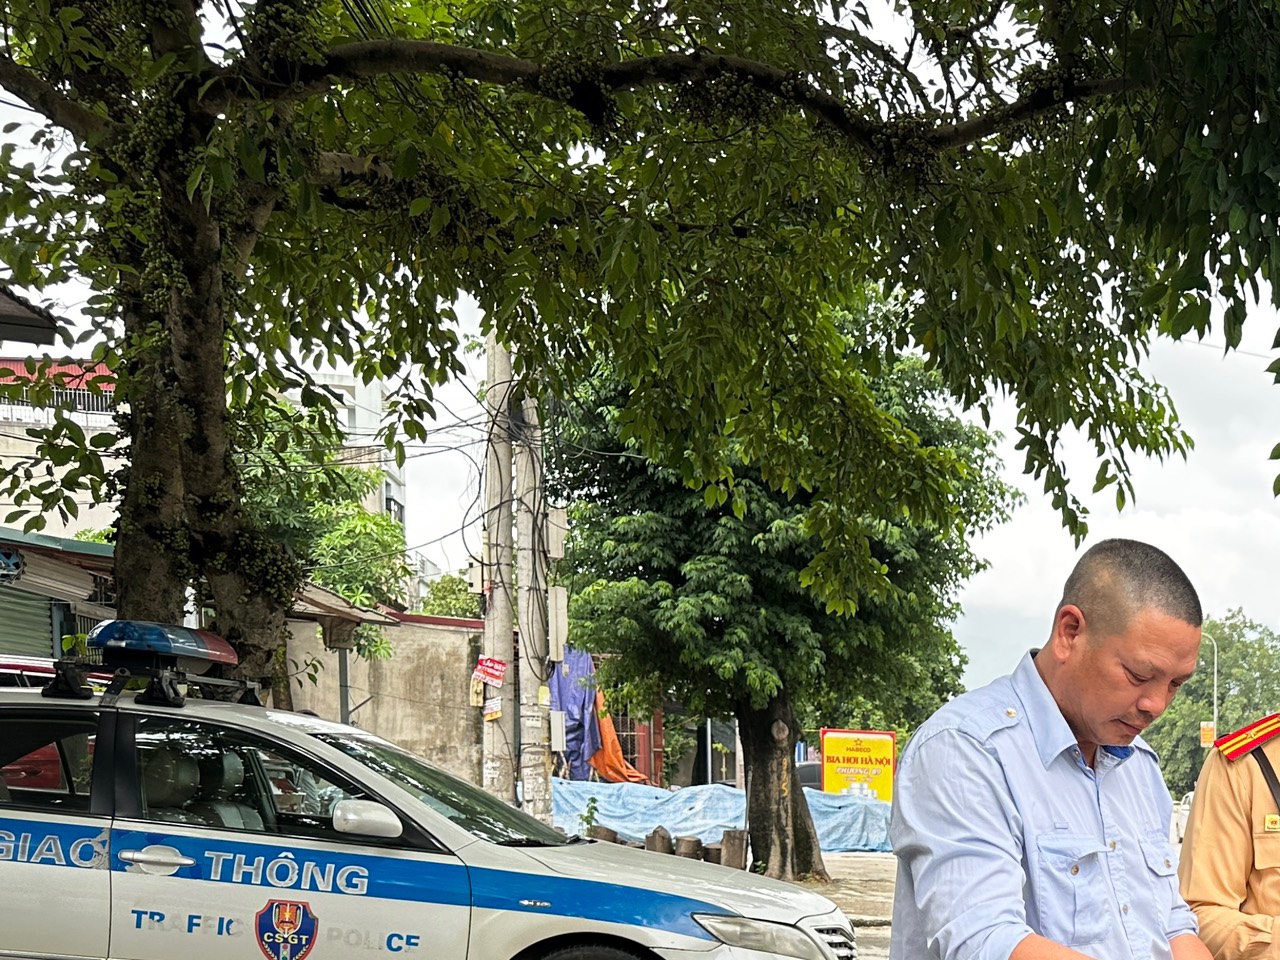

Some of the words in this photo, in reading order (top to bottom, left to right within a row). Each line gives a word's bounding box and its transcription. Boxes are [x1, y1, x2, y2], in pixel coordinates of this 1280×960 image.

[826, 755, 840, 764] BIA
[860, 755, 874, 765] HÀ
[874, 756, 891, 767] NỘI
[203, 850, 370, 896] THÔNG
